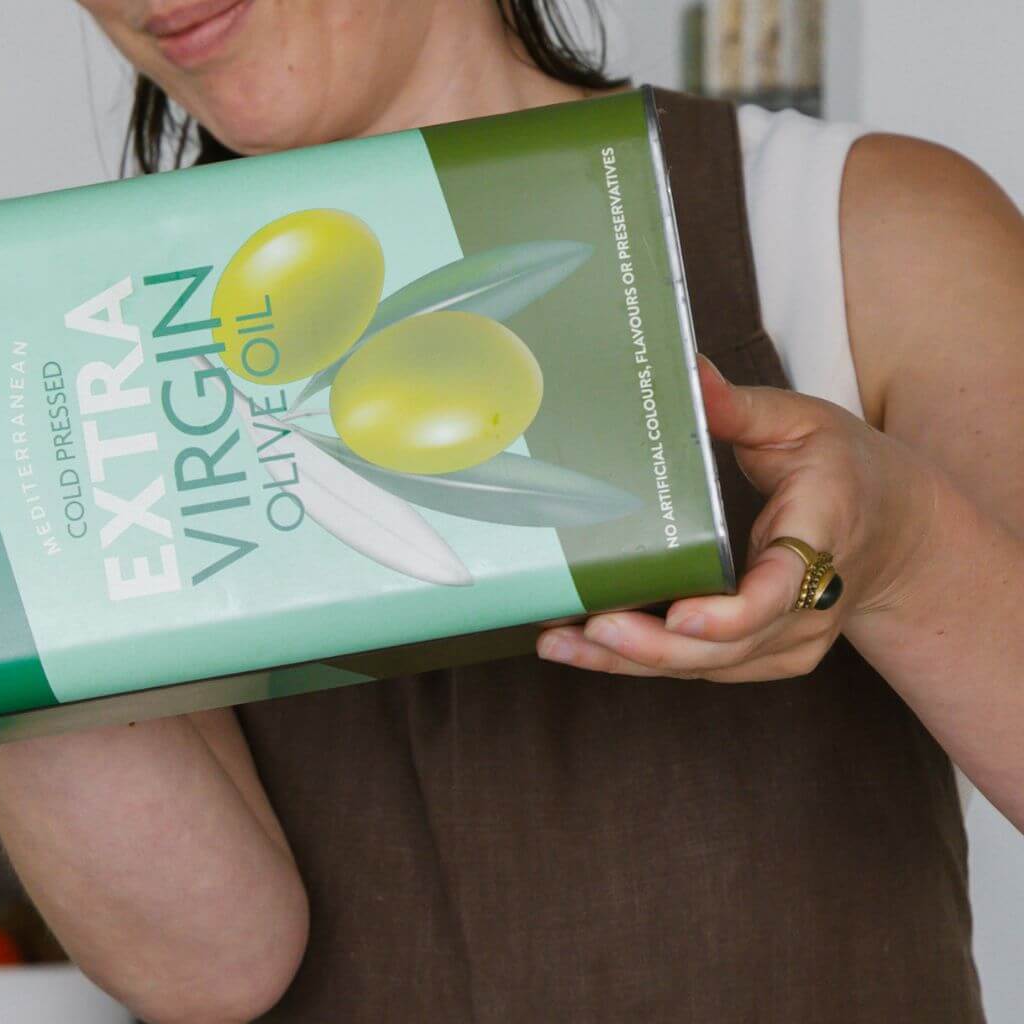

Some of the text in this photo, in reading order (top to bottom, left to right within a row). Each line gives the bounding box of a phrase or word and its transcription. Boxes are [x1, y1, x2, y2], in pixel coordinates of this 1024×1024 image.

[7, 340, 62, 556] MEDITERRANEAN
[42, 360, 88, 539] COLD PRESSED
[64, 275, 182, 601] EXTRA
[143, 265, 260, 586] VIRGIN
[235, 294, 305, 532] OLIVE OIL
[601, 146, 679, 549] NO ARTIFICIAL COLOURS, FLAVOURS OR PRESERVATIVES
